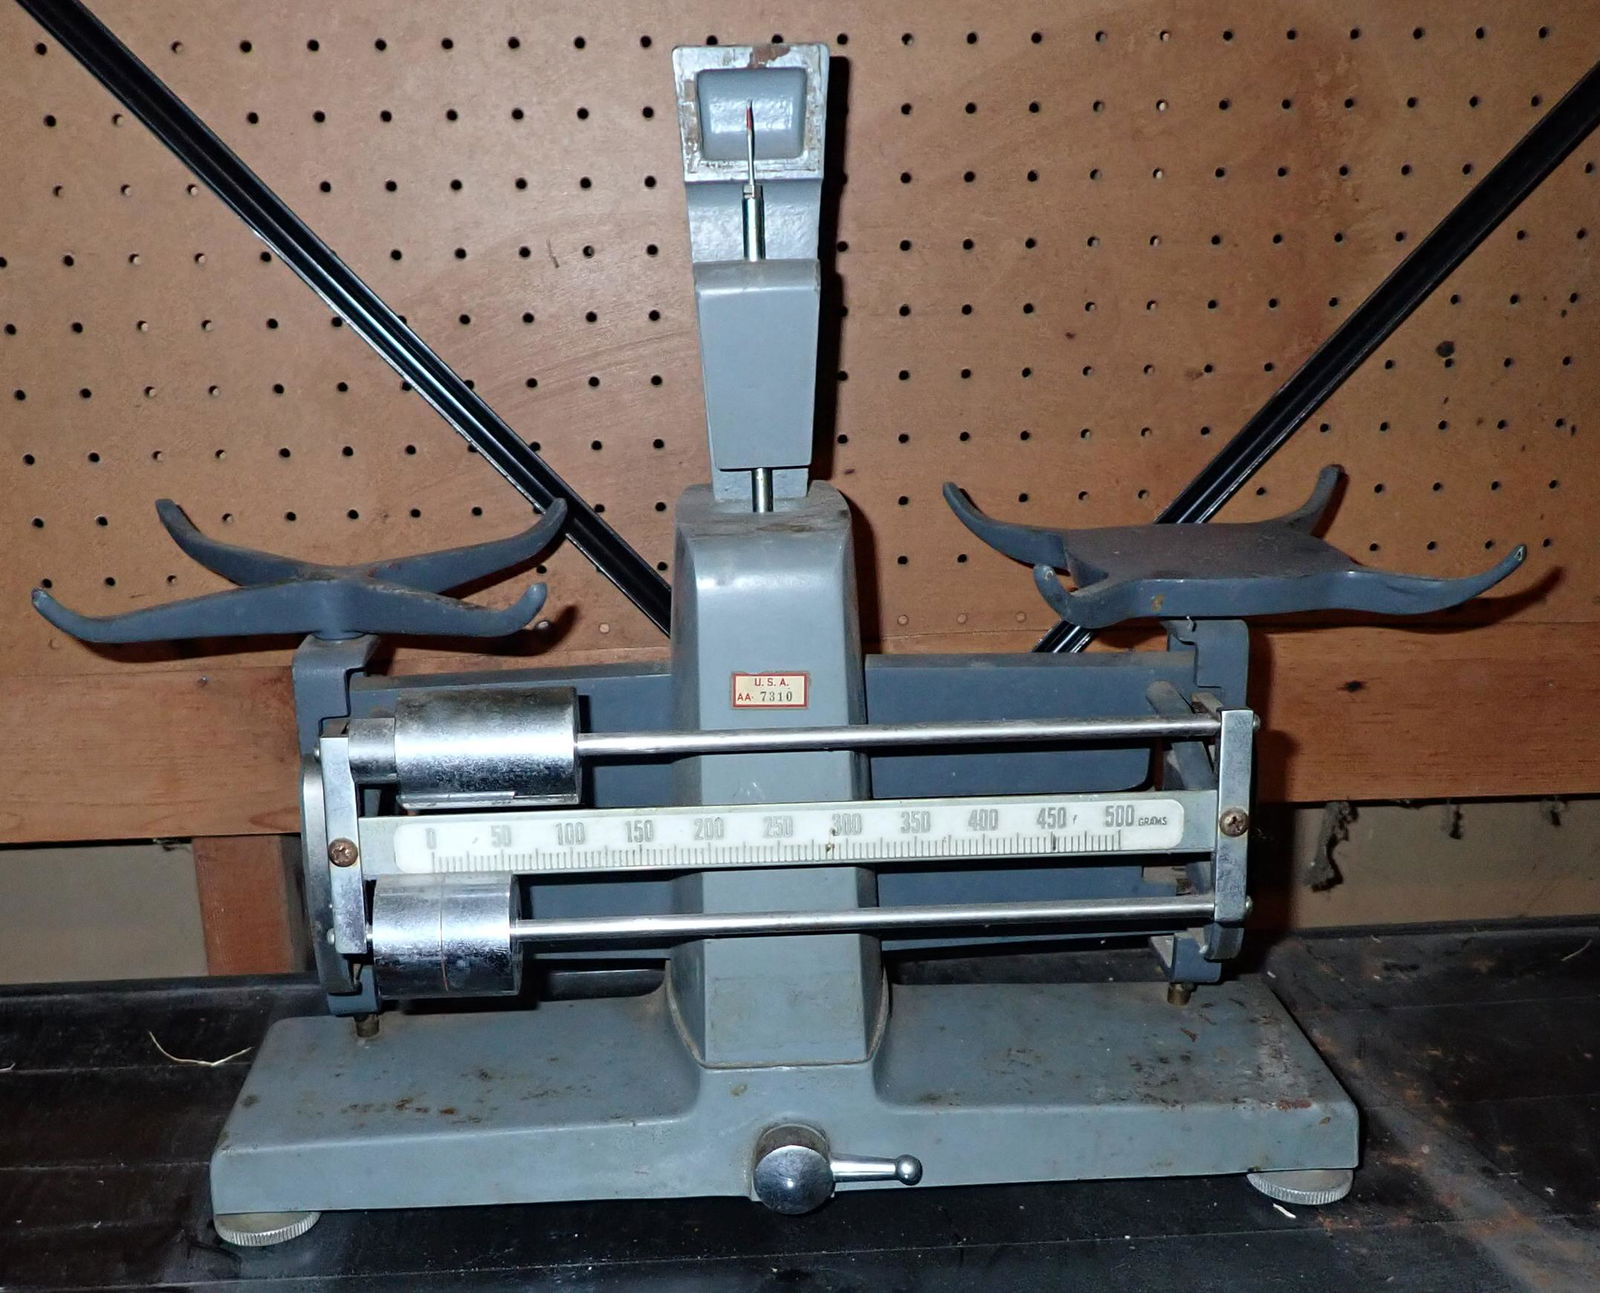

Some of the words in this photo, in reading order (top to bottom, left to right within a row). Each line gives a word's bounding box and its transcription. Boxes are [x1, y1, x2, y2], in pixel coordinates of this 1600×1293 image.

[760, 691, 793, 702] 7310
[425, 827, 437, 850] 0
[490, 824, 512, 848] 50
[555, 821, 586, 846] 100
[624, 819, 655, 843] 150
[693, 816, 725, 841] 200
[762, 814, 794, 839] 250
[832, 812, 863, 836] 300
[900, 810, 931, 834] 350
[967, 808, 999, 832] 400
[1036, 806, 1067, 830] 450
[1105, 804, 1136, 828] 500
[1137, 816, 1168, 828] GRAMS
